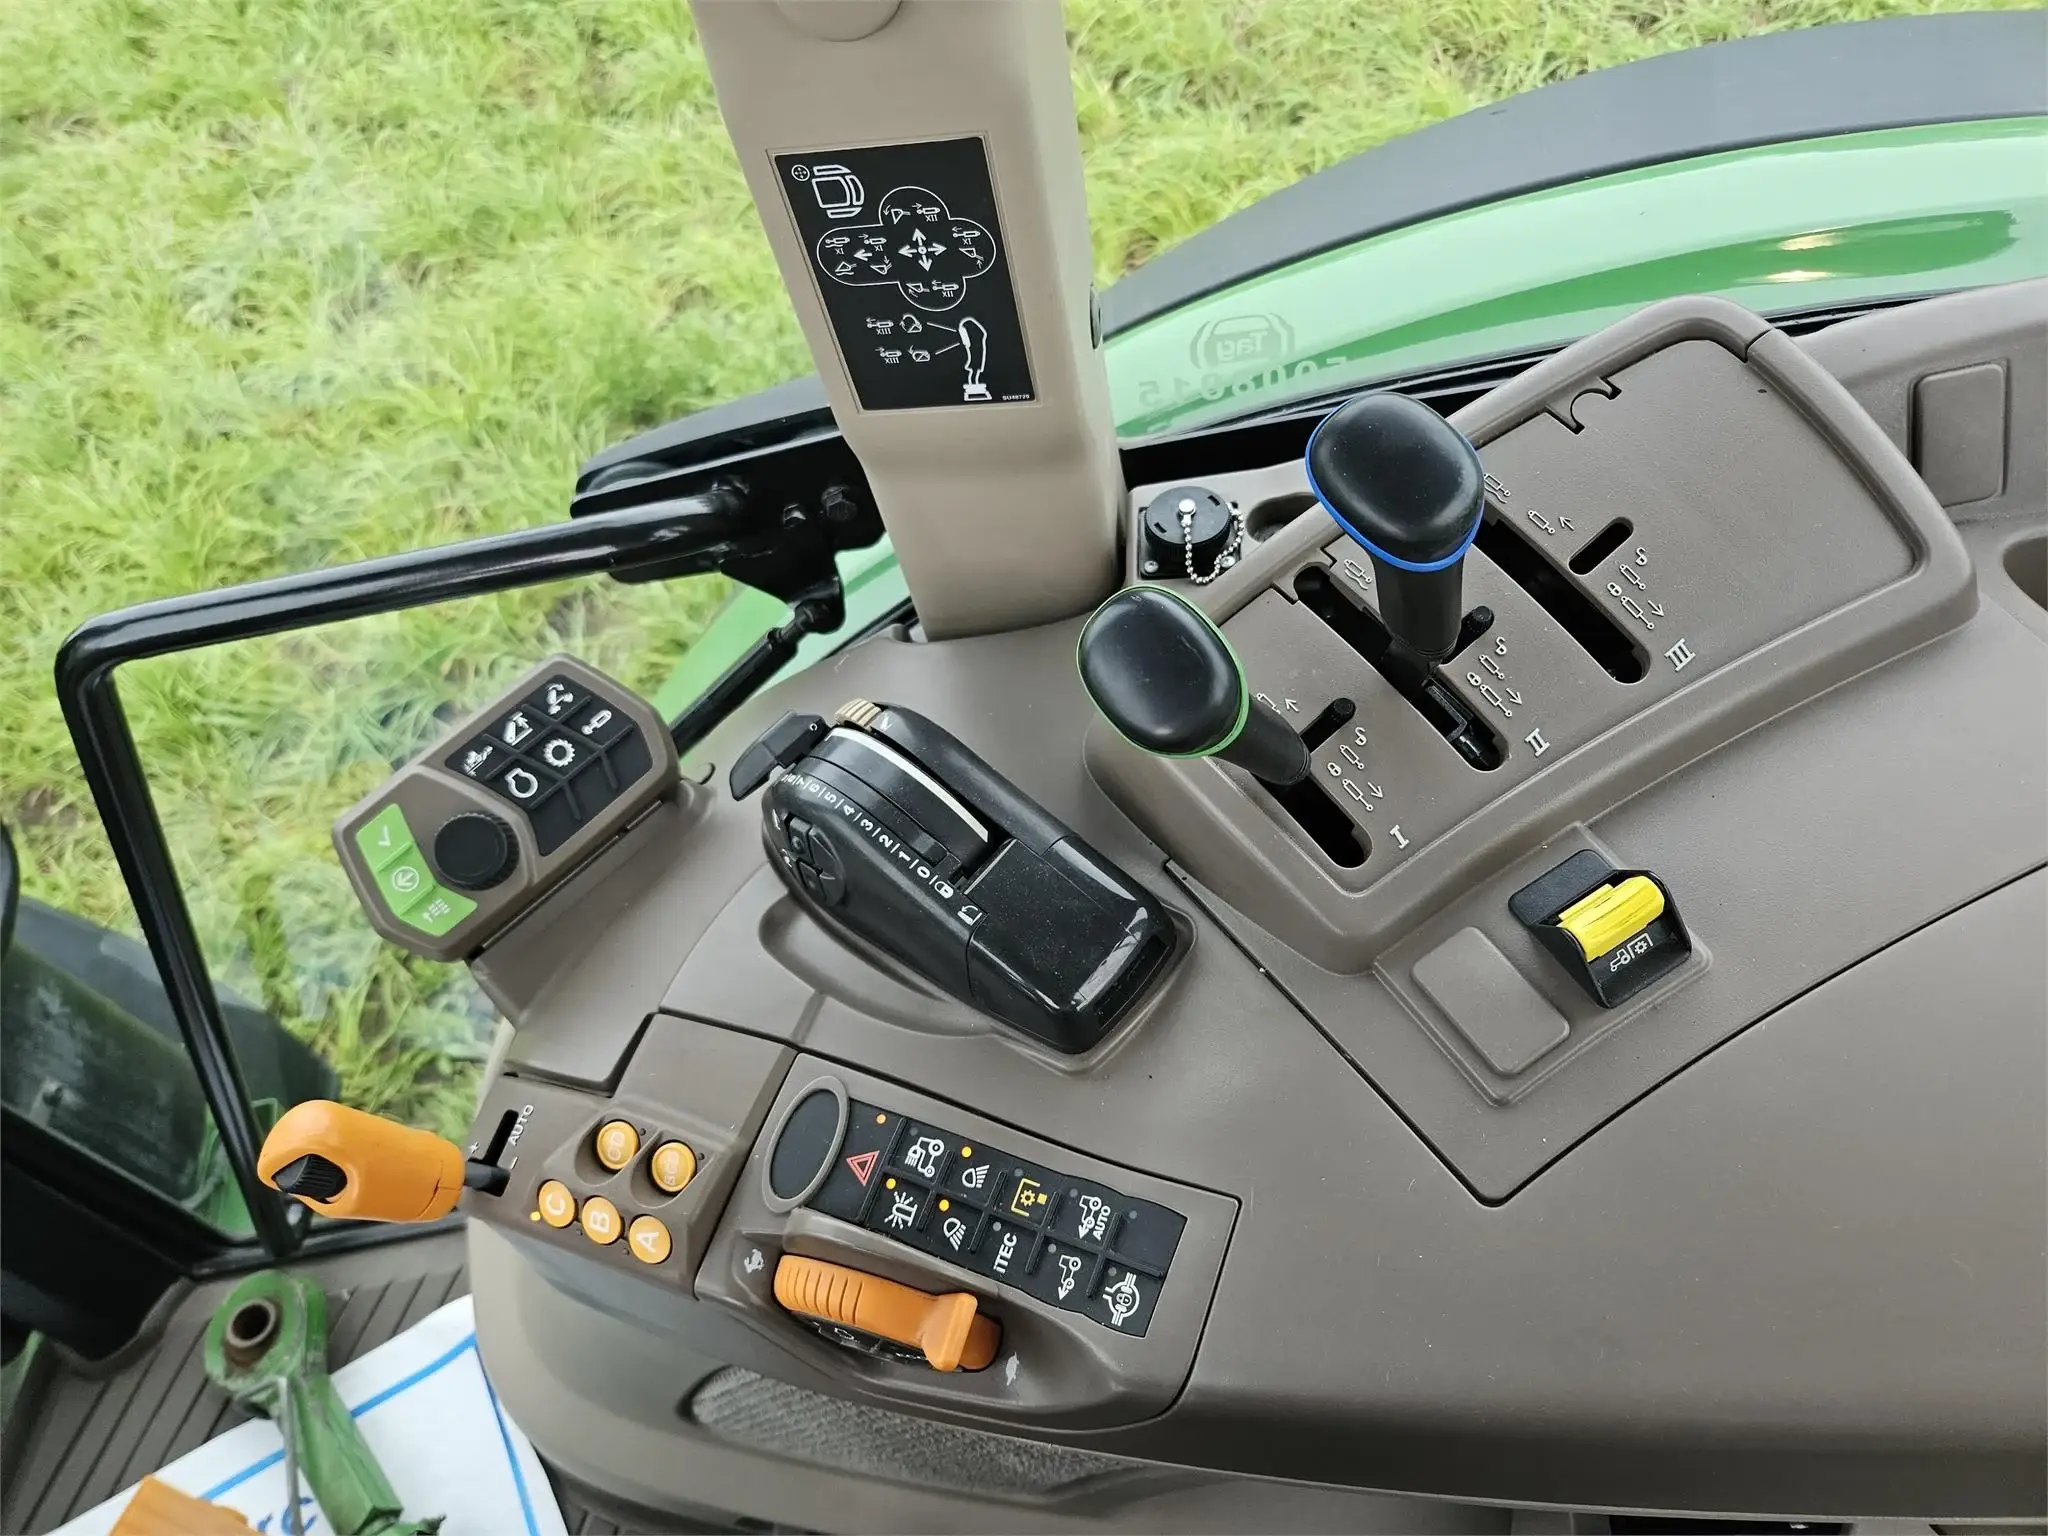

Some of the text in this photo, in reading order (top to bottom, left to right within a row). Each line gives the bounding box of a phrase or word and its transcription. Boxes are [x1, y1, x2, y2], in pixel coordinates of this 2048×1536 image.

[924, 214, 938, 222] XII
[873, 244, 884, 252] XI
[962, 237, 972, 245] XI
[834, 247, 845, 255] XI
[941, 290, 954, 298] XII
[1663, 637, 1697, 673] III
[1524, 727, 1551, 757] II
[823, 791, 838, 804] 5
[842, 804, 856, 817] 4
[860, 818, 874, 832] 3
[878, 834, 894, 849] 2
[1389, 824, 1410, 849] I
[898, 850, 912, 863] 1
[917, 865, 931, 879] 0
[508, 1103, 535, 1147] AUTO
[545, 1193, 566, 1216] C
[589, 1210, 611, 1234] B
[1091, 1204, 1112, 1241] AUTO
[635, 1230, 660, 1253] A
